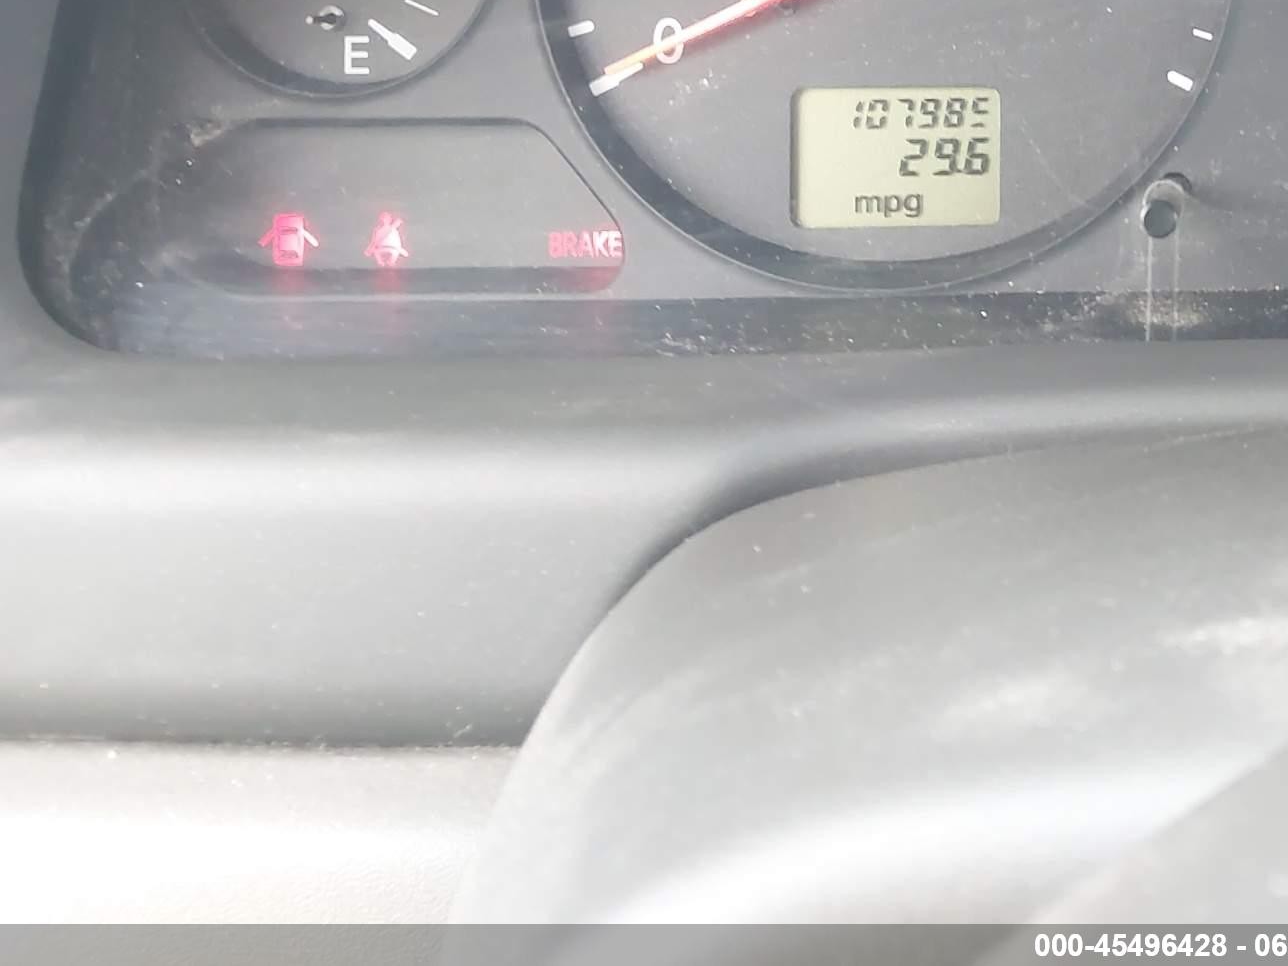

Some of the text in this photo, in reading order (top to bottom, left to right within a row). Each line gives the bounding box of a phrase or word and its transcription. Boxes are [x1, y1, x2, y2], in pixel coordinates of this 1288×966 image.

[344, 36, 369, 74] E
[653, 18, 684, 63] 0
[899, 137, 990, 176] 29.6
[855, 194, 923, 218] mpg
[549, 233, 622, 257] BRAKE
